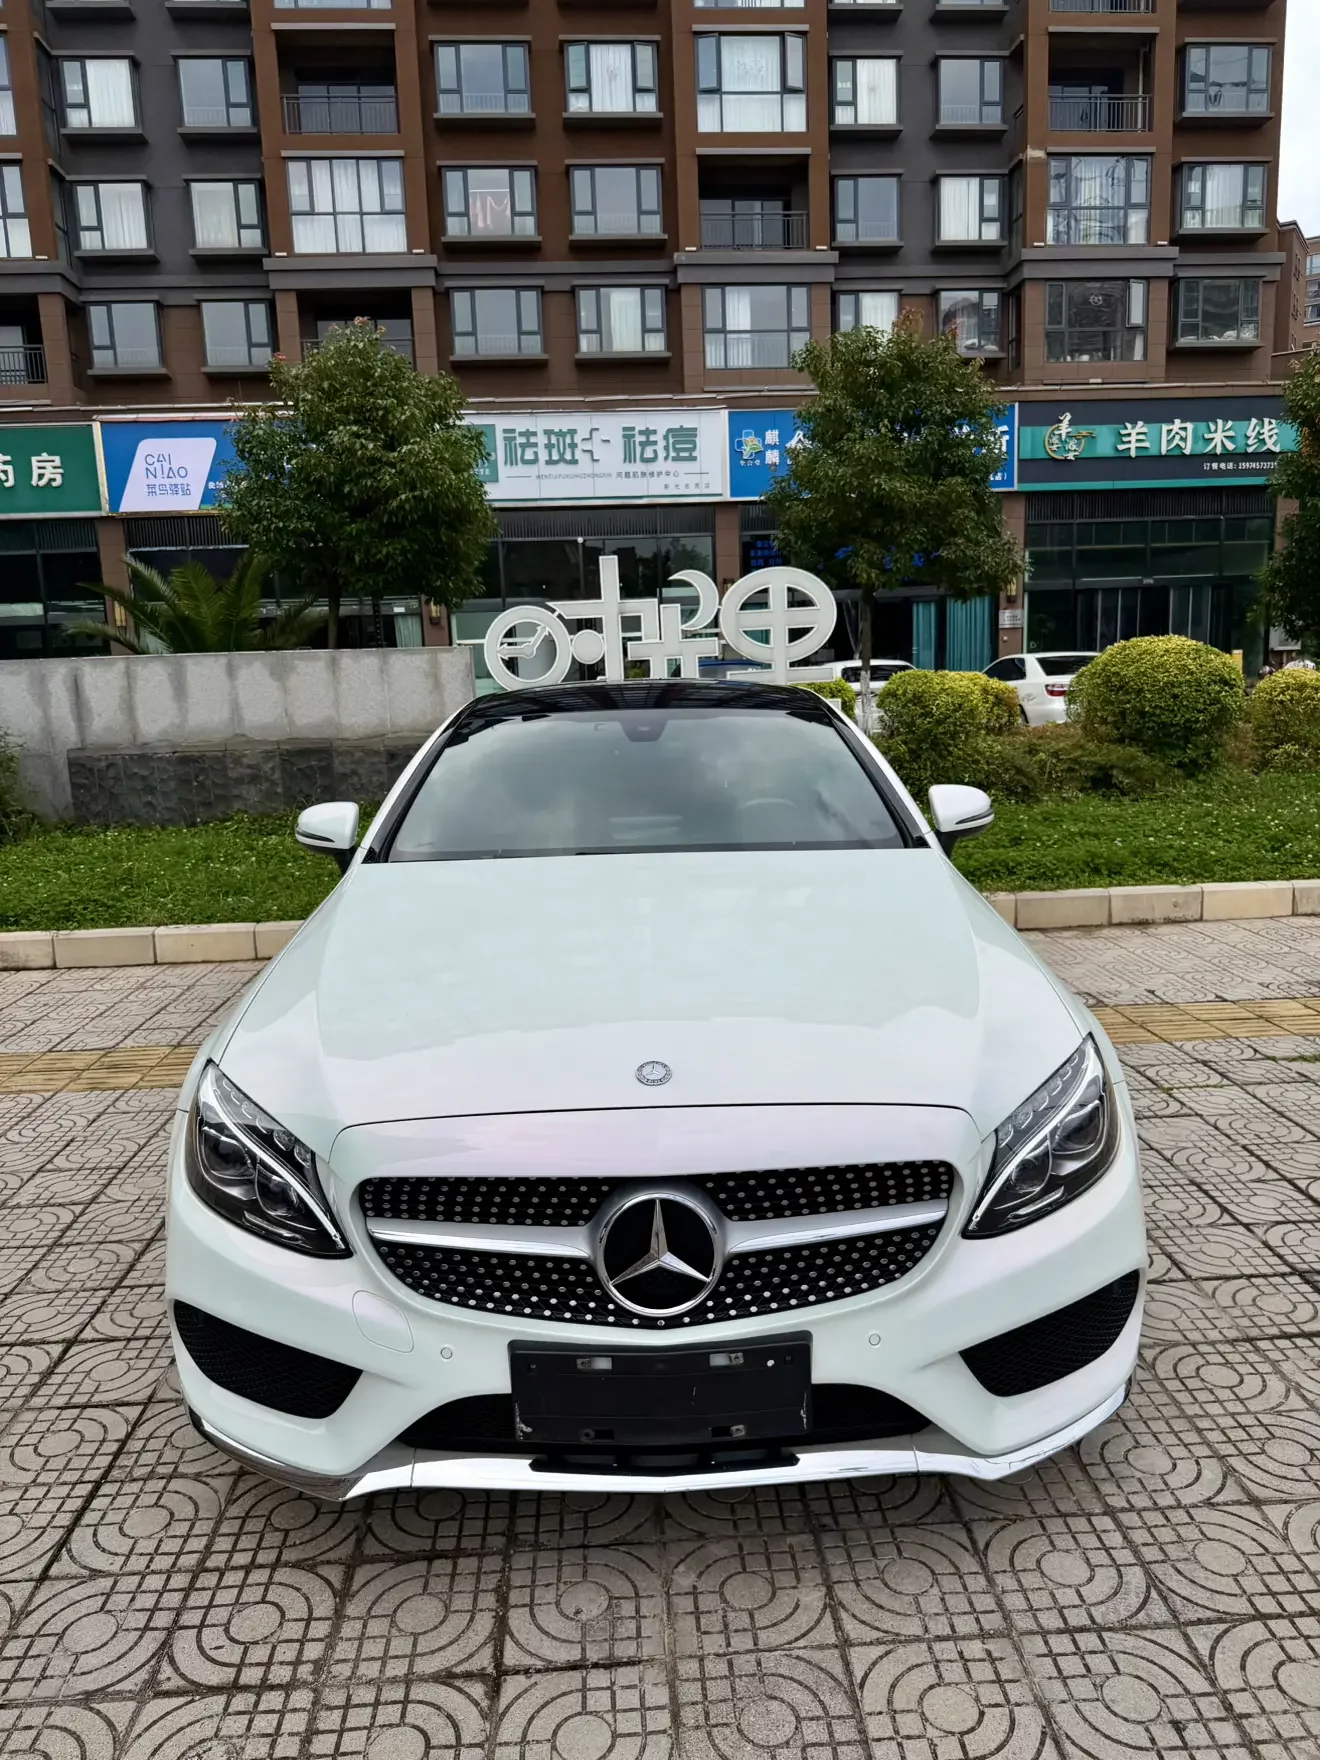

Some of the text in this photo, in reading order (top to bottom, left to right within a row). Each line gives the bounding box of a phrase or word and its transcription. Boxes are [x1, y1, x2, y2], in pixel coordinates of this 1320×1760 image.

[502, 427, 579, 467] 祛斑
[621, 425, 698, 464] 祛痘
[1116, 417, 1281, 458] 羊肉米线
[146, 483, 192, 497] 菜鸟驿站
